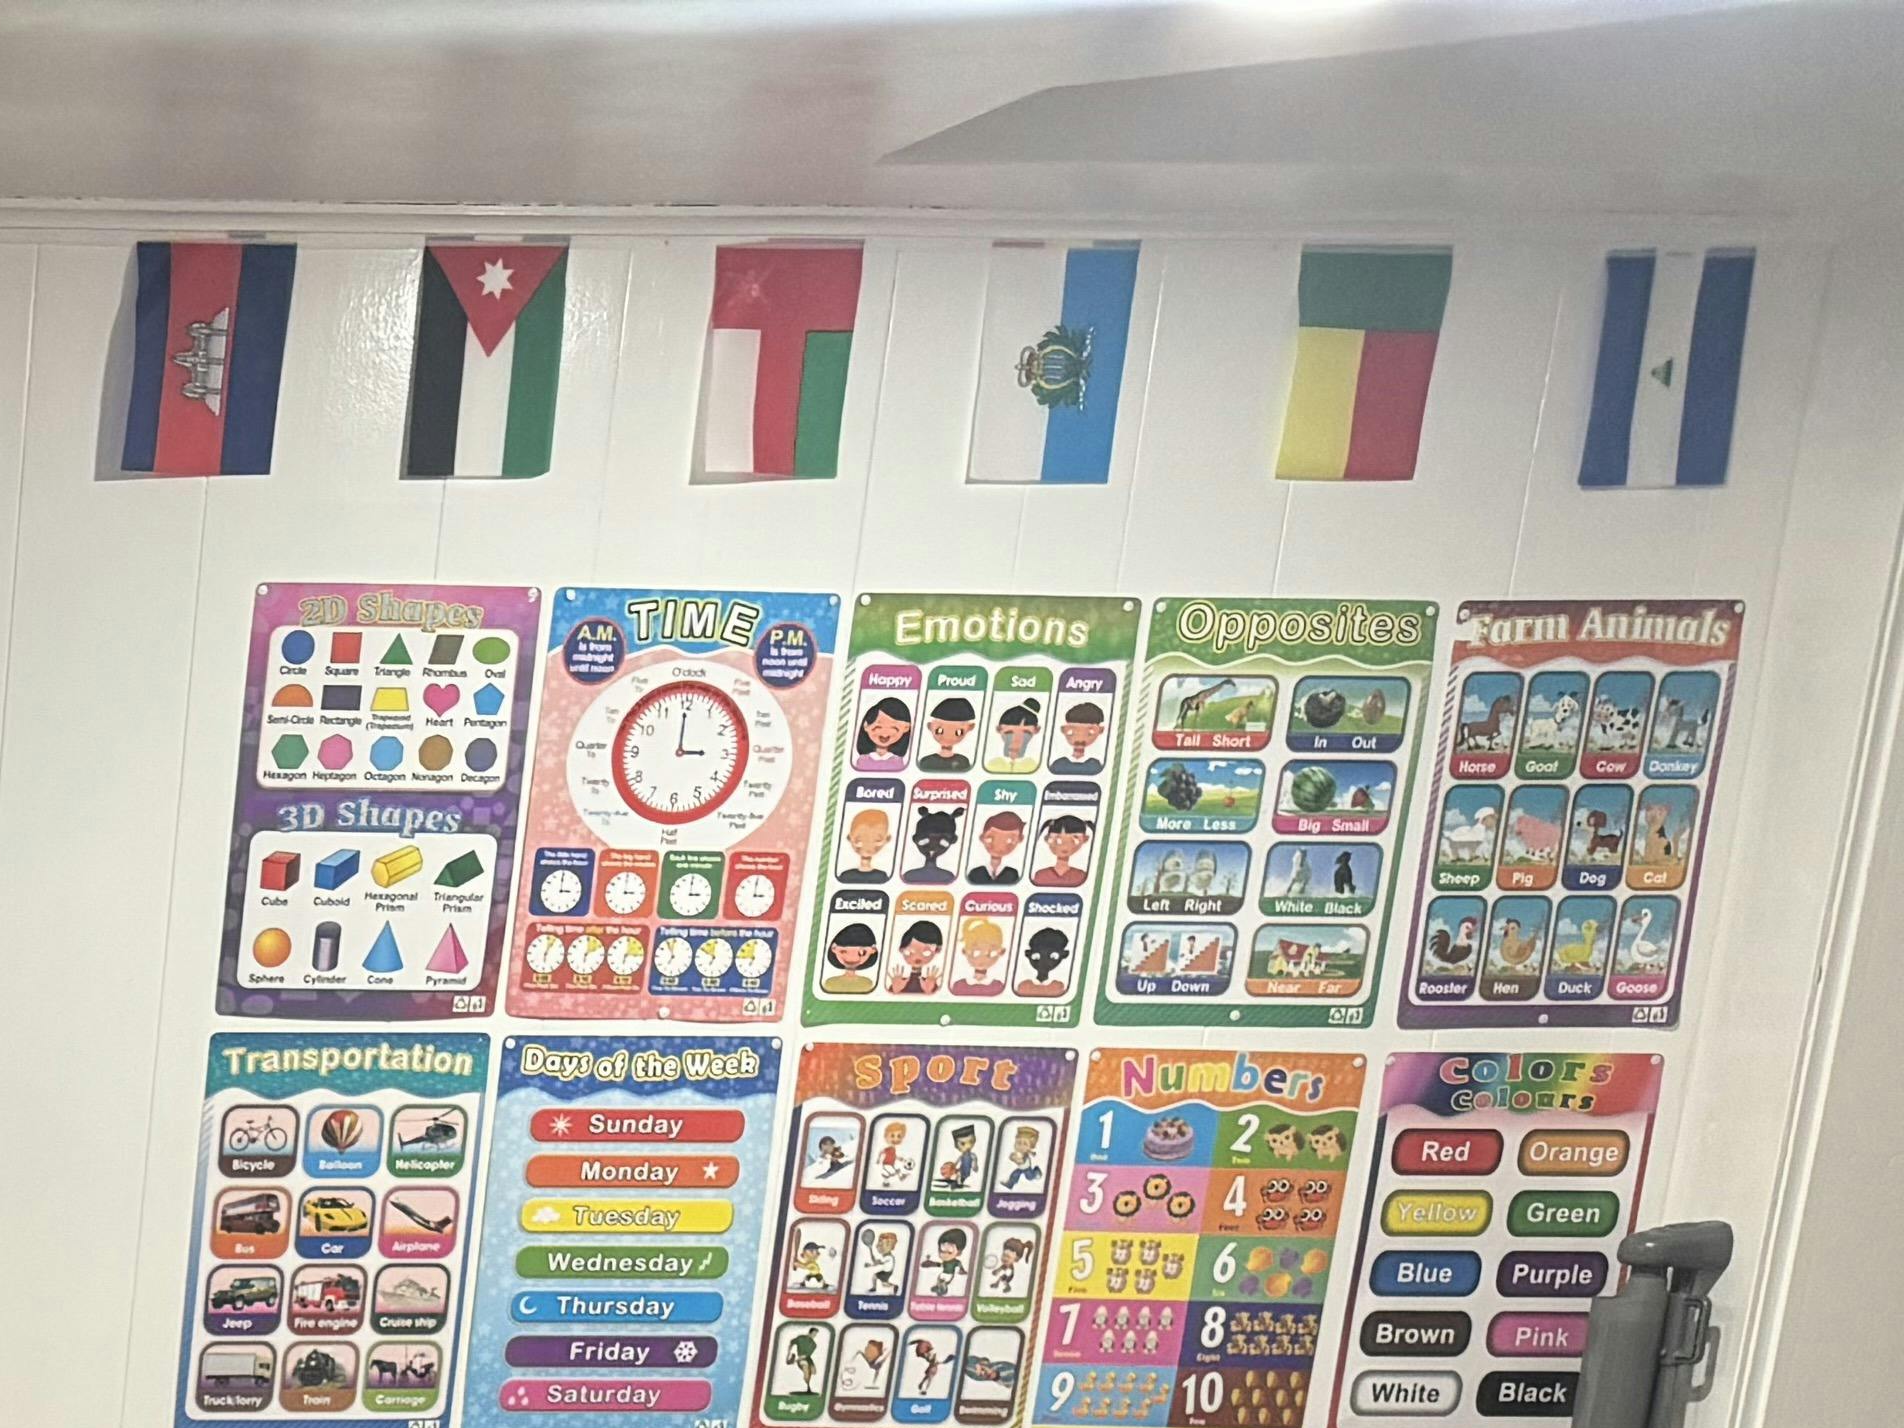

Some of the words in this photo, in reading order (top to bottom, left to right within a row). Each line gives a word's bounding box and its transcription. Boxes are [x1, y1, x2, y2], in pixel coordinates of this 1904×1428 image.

[299, 595, 347, 625] 2D
[358, 591, 483, 632] Shapes
[628, 600, 760, 647] TIME
[895, 607, 1089, 647] Emotions
[1178, 601, 1421, 652] Opposites
[1469, 612, 1570, 646] Farm
[1578, 606, 1729, 646] Animals
[577, 625, 616, 641] A.M.
[771, 631, 807, 646] P.M.
[325, 667, 358, 676] Square
[375, 667, 410, 678] Triangle
[869, 674, 912, 687] Happy
[938, 675, 976, 686] Proud
[1011, 676, 1036, 688] Sad
[1066, 677, 1102, 691] Angry
[680, 700, 692, 711] 12
[426, 718, 453, 727] Heart
[465, 718, 506, 727] Pentagon
[641, 725, 654, 736] 10
[1175, 735, 1200, 747] Tall
[1212, 735, 1250, 748] Short
[1314, 736, 1327, 748] In
[1352, 737, 1376, 749] Out
[631, 747, 639, 758] 9
[1460, 762, 1496, 773] Horse
[1525, 762, 1557, 773] Goat
[1596, 762, 1626, 773] Cow
[365, 772, 405, 782] Octagon
[461, 773, 500, 784] Decagon
[670, 793, 678, 804] 6
[856, 787, 893, 798] Bored
[914, 788, 967, 800] Surprised
[995, 788, 1017, 802] Shy
[278, 805, 325, 830] 3D
[338, 799, 461, 838] Shapes
[1156, 818, 1191, 830] More
[1204, 819, 1236, 831] Less
[1299, 819, 1320, 833] Big
[1332, 820, 1369, 832] Small
[1439, 873, 1480, 886] Sheep
[1513, 873, 1533, 886] Pig
[1579, 873, 1606, 886] Dog
[1644, 873, 1667, 884] Cat
[261, 897, 288, 906] Cube
[902, 900, 947, 911] Scared
[965, 901, 1013, 912] Curious
[1028, 902, 1079, 914] Shocked
[1144, 899, 1170, 911] Left
[1185, 900, 1222, 913] Right
[1275, 901, 1313, 913] White
[1325, 902, 1361, 914] Black
[249, 974, 284, 984] Sphere
[367, 976, 393, 984] Cone
[426, 976, 466, 986] Pyramid
[1138, 980, 1156, 993] Up
[1172, 980, 1209, 993] Down
[1267, 982, 1301, 994] Near
[1318, 982, 1341, 994] Far
[1419, 982, 1467, 995] Rooster
[1494, 983, 1518, 994] Hen
[1558, 983, 1592, 995] Duck
[1616, 983, 1657, 995] Goose
[223, 1043, 473, 1076] Transportation
[523, 1048, 590, 1076] Days
[597, 1053, 627, 1080] of
[635, 1054, 676, 1080] the
[684, 1050, 758, 1078] Week
[1440, 1054, 1613, 1084] Colors
[1122, 1053, 1325, 1102] Numbers
[589, 1114, 682, 1138] Sunday
[1099, 1110, 1114, 1149] 1
[1230, 1114, 1260, 1153] 2
[1422, 1141, 1470, 1162] Red
[1530, 1142, 1619, 1166] Orange
[232, 1160, 275, 1172] Bicycle
[396, 1160, 456, 1172] Helicopter
[581, 1161, 678, 1185] Monday
[1079, 1171, 1108, 1214] 3
[1223, 1175, 1247, 1216] 4
[872, 1197, 905, 1206] Soccer
[997, 1199, 1035, 1211] Jogging
[573, 1205, 680, 1228] Tuesday
[1398, 1203, 1478, 1223] Yellow
[1527, 1202, 1600, 1224] Green
[235, 1244, 254, 1254] Bus
[321, 1243, 343, 1254] Car
[392, 1242, 440, 1254] Airplane
[548, 1252, 693, 1276] Wednesday
[1068, 1238, 1094, 1280] 5
[1213, 1242, 1237, 1283] 6
[1397, 1262, 1452, 1283] Blue
[1512, 1264, 1592, 1289] Purple
[557, 1297, 674, 1319] Thursday
[858, 1301, 888, 1311] Tennis
[223, 1318, 252, 1330] Jeep
[294, 1318, 315, 1328] Fire
[318, 1318, 358, 1330] engine
[379, 1318, 411, 1328] Cruise
[415, 1318, 436, 1330] ship
[1059, 1303, 1081, 1345] 7
[1201, 1306, 1226, 1348] 8
[1375, 1324, 1455, 1344] Brown
[1515, 1328, 1568, 1347] Pink
[570, 1342, 649, 1365] Friday
[547, 1385, 661, 1406] Saturday
[1050, 1372, 1075, 1411] 9
[1182, 1372, 1223, 1415] 10
[1371, 1384, 1440, 1403] White
[1498, 1383, 1568, 1402] Black
[304, 1396, 330, 1405] Train
[911, 1404, 931, 1414] Golf
